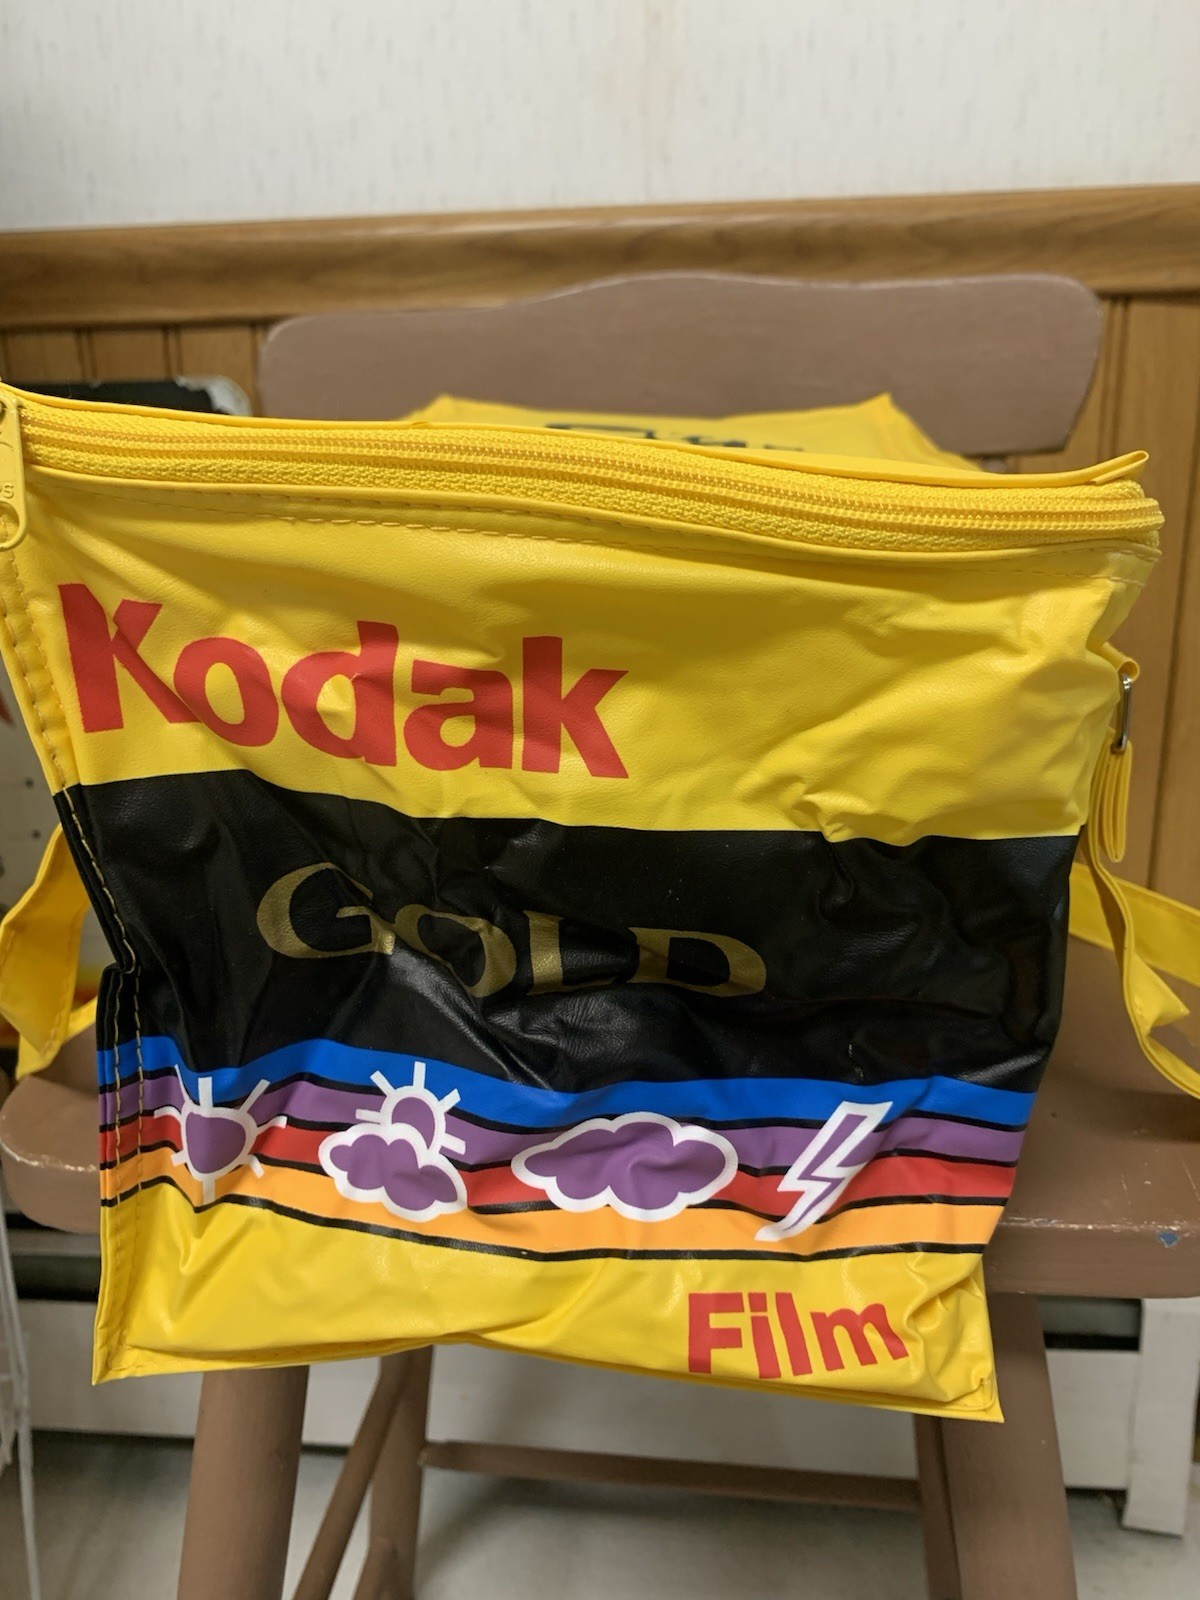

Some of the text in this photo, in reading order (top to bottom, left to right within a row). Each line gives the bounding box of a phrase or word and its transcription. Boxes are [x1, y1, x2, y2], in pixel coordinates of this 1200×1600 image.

[58, 582, 629, 778] Kodak
[256, 862, 767, 998] GOLD
[688, 1292, 909, 1379] Film
